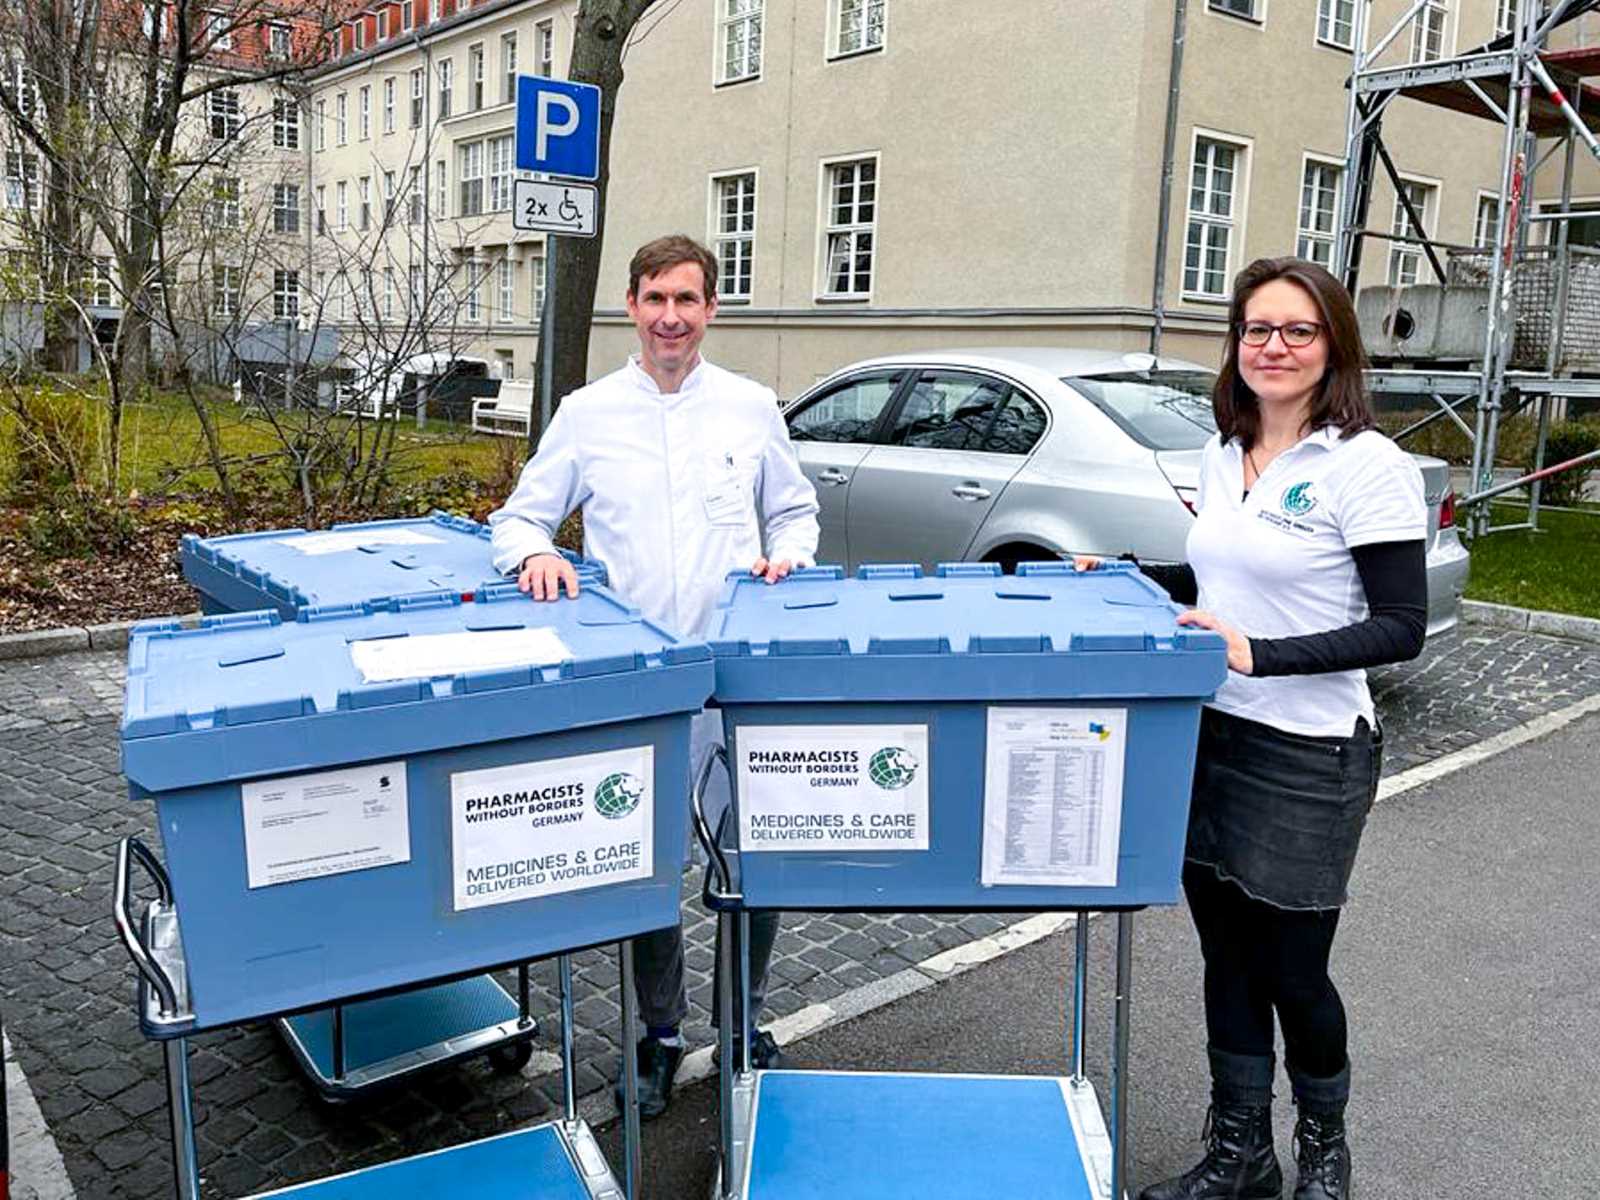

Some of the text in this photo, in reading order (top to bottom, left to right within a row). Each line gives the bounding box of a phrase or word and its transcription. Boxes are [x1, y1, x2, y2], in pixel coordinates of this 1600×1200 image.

[536, 90, 580, 161] P
[525, 197, 548, 217] 2x
[749, 750, 859, 763] PHARMACISTS
[749, 764, 859, 774] WITHOUT BORDERS
[810, 777, 859, 787] GERMANY
[466, 783, 584, 812] PHARMACISTS
[466, 797, 584, 824] WITHOUT BORDERS
[532, 811, 584, 828] GERMANY
[751, 814, 916, 827] MEDICINES & CARE
[751, 828, 915, 840] DELIVERED WORLDWIDE
[466, 841, 641, 883] MEDICINES & CARE
[466, 857, 639, 896] DELIVERED WORLDWIDE
